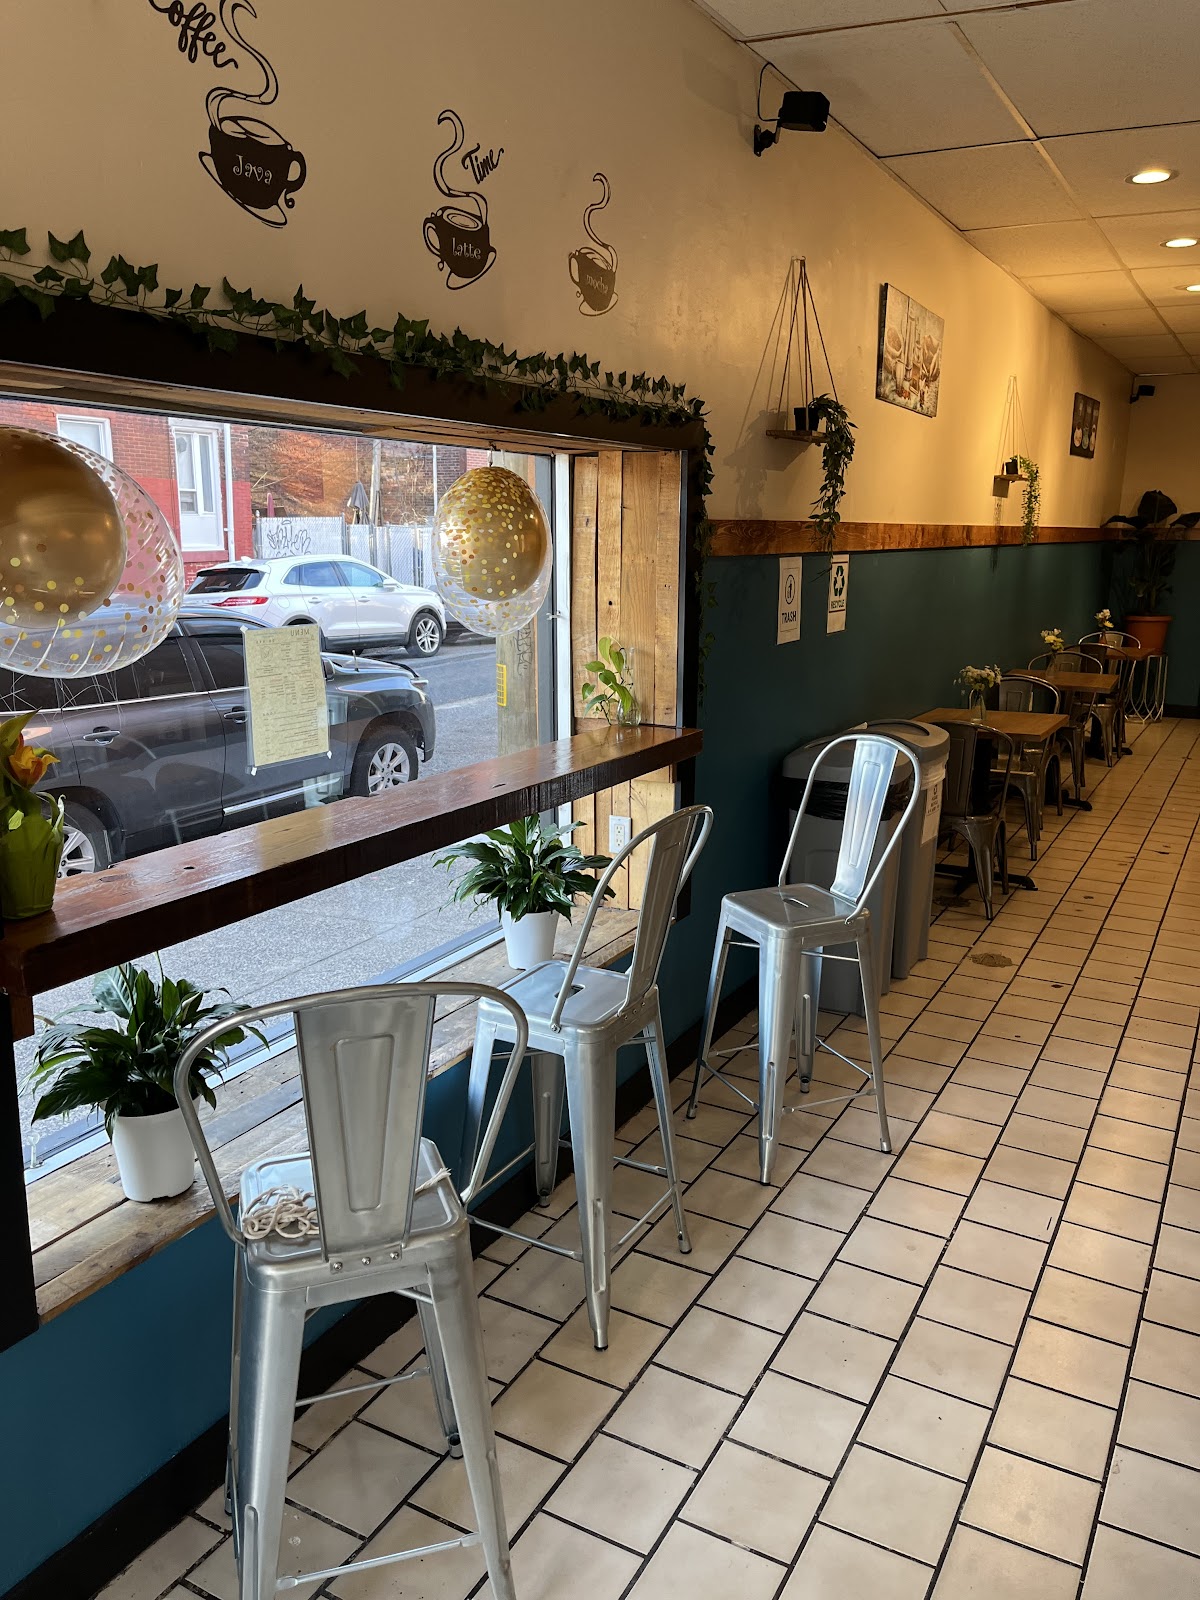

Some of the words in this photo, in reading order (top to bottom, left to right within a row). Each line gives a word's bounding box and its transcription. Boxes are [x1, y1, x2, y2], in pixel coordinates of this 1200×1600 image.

[149, 0, 239, 69] offee
[232, 153, 273, 185] Java
[461, 143, 504, 184] Time
[452, 237, 481, 260] latte
[781, 611, 797, 624] TRASH
[830, 600, 845, 610] RECYCLE
